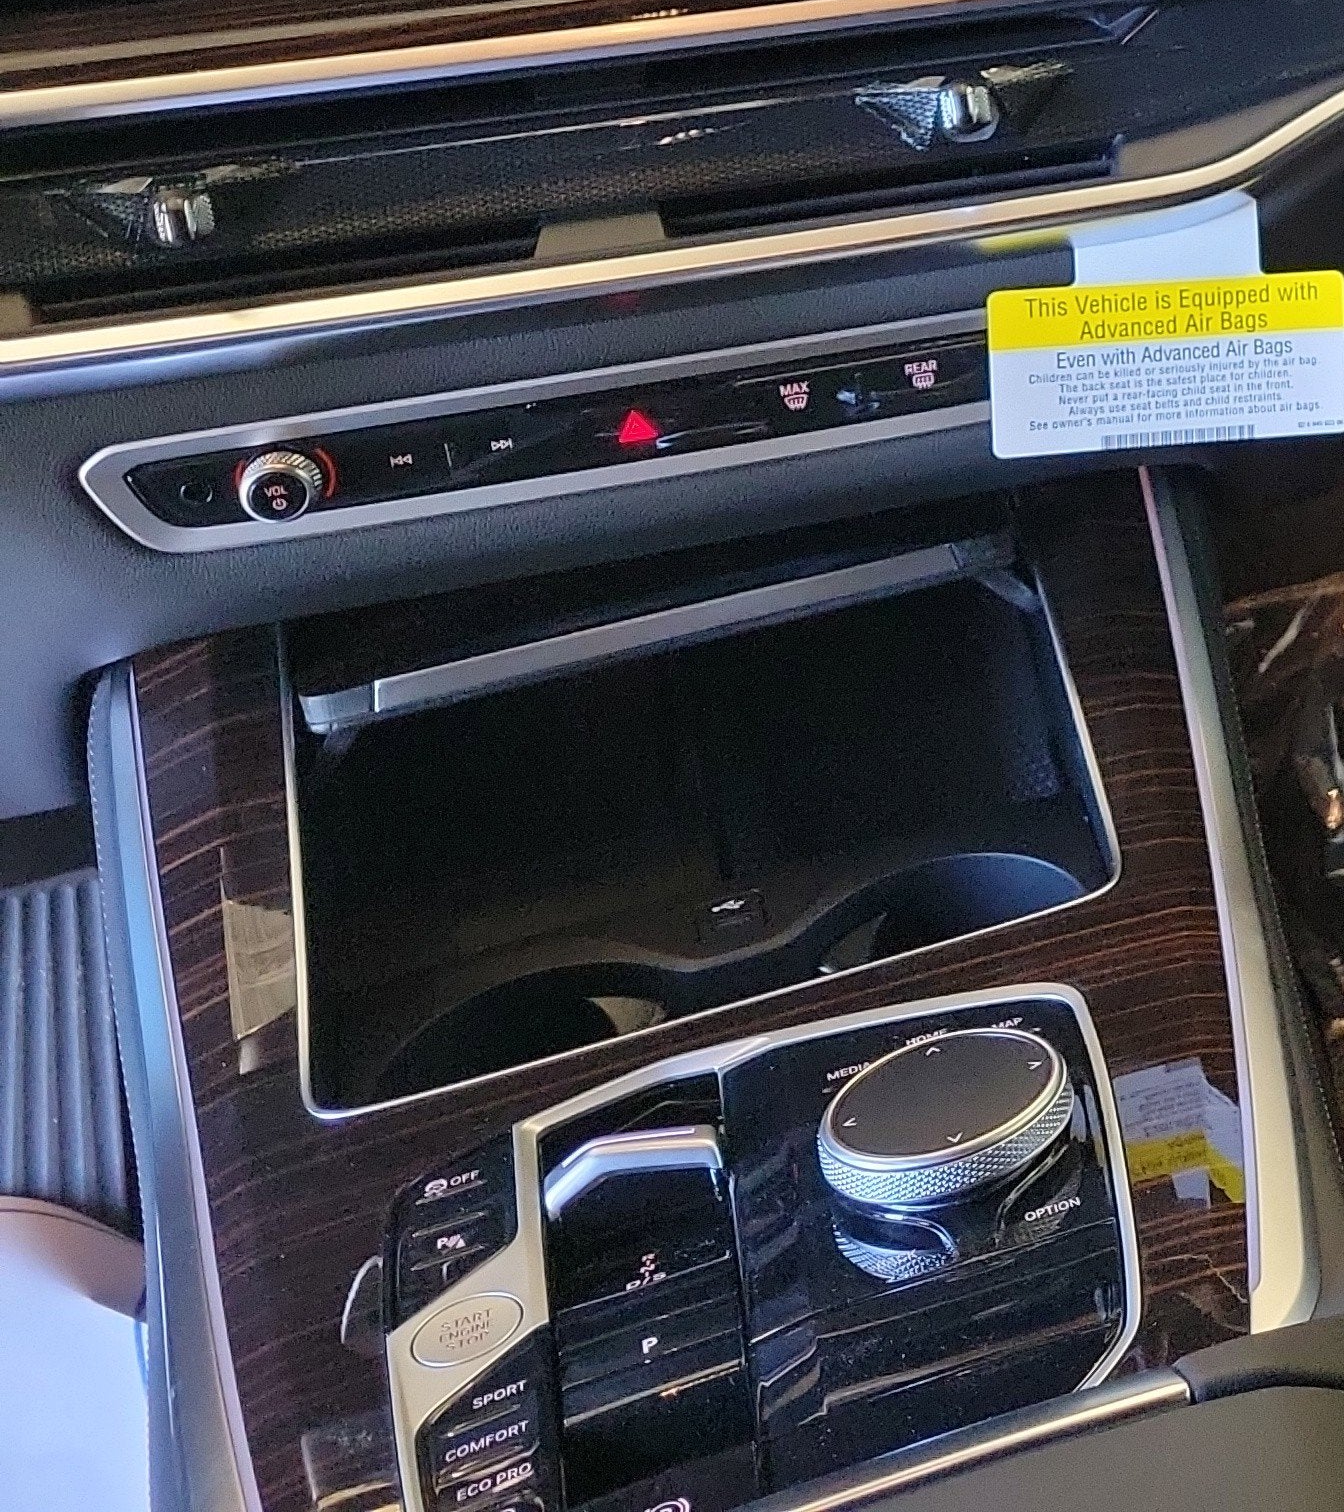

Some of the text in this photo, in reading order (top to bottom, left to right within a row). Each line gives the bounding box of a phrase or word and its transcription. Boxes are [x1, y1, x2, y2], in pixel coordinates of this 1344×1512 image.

[1024, 281, 1318, 320] This Vehicle is Equipped with
[1080, 310, 1268, 341] Advanced Air Bags
[1056, 339, 1293, 370] Even with Advanced Air Bags
[904, 359, 938, 376] REAR
[1029, 371, 1072, 385] Children
[1076, 372, 1094, 381] can
[1098, 370, 1110, 379] be
[1114, 367, 1141, 378] killed
[1145, 366, 1155, 376] or
[1159, 362, 1206, 375] seriously
[1209, 360, 1244, 373] injured
[1248, 359, 1260, 370] by
[1264, 358, 1279, 368] the
[1283, 356, 1295, 366] air
[779, 380, 810, 397] MAX
[1058, 394, 1088, 405] Never
[1092, 393, 1109, 405] put
[1112, 392, 1119, 401] a
[1122, 388, 1178, 402] rear-facing
[1181, 385, 1206, 396] child
[1209, 383, 1231, 394] seat
[1234, 382, 1244, 392] in
[1247, 381, 1263, 391] the
[1059, 383, 1078, 393] The
[1082, 381, 1106, 392] back
[1110, 380, 1131, 390] seat
[1134, 378, 1144, 388] is
[1147, 377, 1163, 387] the
[1166, 375, 1197, 386] safest
[1200, 373, 1226, 385] place
[1230, 371, 1245, 381] for
[1029, 421, 1048, 431] See
[1052, 416, 1093, 430] owner's
[1096, 413, 1134, 426] manual
[1137, 410, 1151, 422] for
[1155, 410, 1182, 421] more
[1185, 405, 1245, 419] information
[1248, 402, 1277, 414] about
[1280, 401, 1293, 412] air
[1069, 405, 1105, 418] Always
[1109, 404, 1127, 413] use
[1130, 402, 1152, 412] seat
[1155, 399, 1180, 410] belts
[1183, 397, 1202, 407] and
[1205, 394, 1230, 406] child
[263, 485, 288, 498] VOL
[992, 1016, 1024, 1030] MAP
[905, 1028, 949, 1047] HOME
[826, 1060, 873, 1082] MEDIA
[450, 1169, 480, 1187] OFF
[1023, 1196, 1082, 1223] OPTION
[439, 1319, 490, 1344] ENGINE
[441, 1308, 491, 1331] START
[445, 1329, 490, 1350] STOP
[641, 1336, 659, 1355] P
[471, 1379, 528, 1410] SPORT
[445, 1419, 530, 1463] COMFORT
[456, 1461, 533, 1503] ECO PRO
